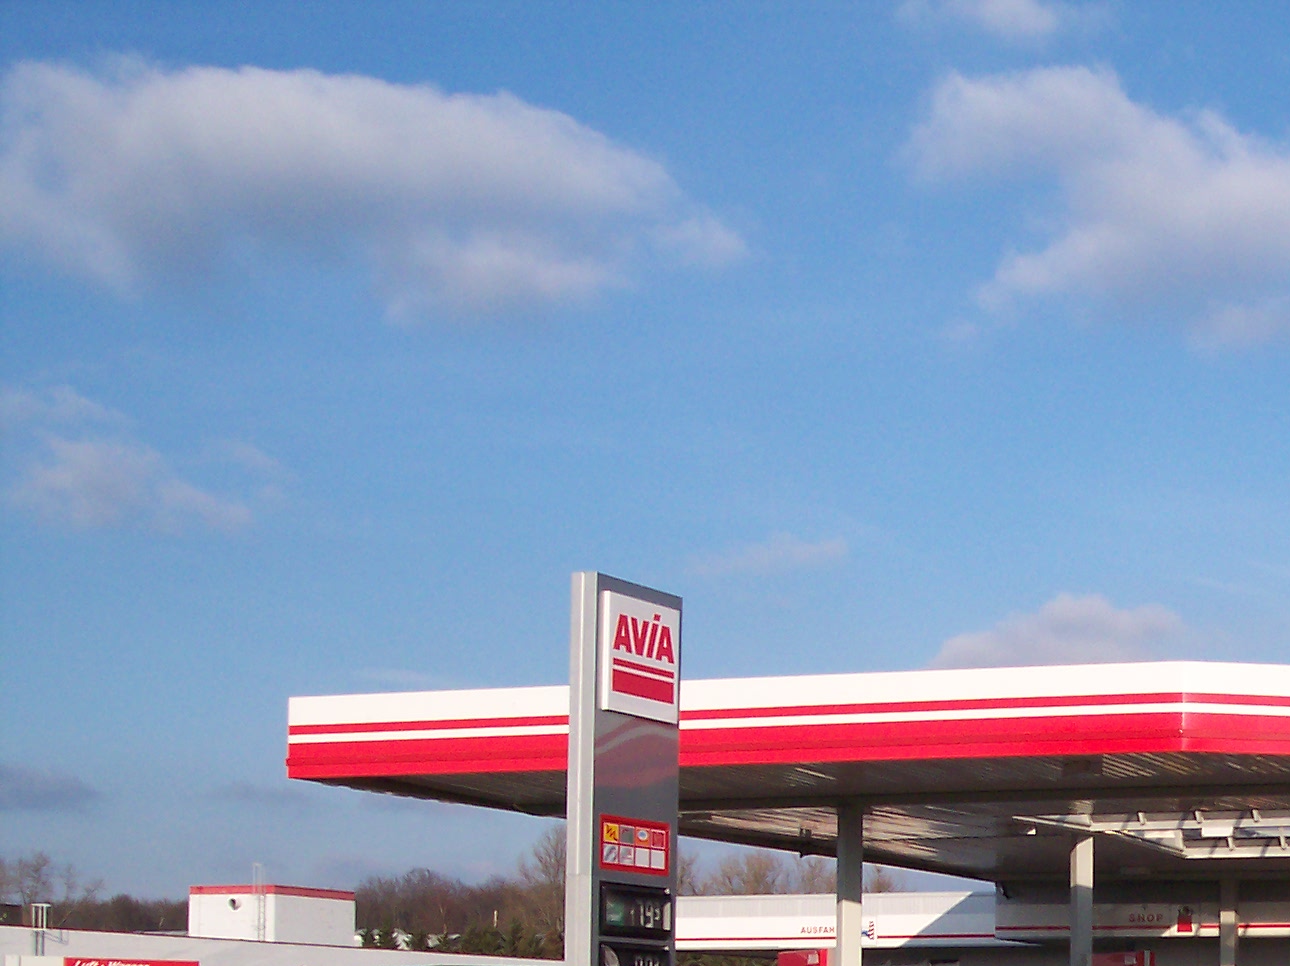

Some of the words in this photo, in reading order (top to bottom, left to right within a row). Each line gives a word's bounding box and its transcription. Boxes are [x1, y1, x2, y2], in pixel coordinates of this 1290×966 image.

[613, 613, 675, 665] AVIA
[1129, 913, 1164, 923] SHOP
[800, 926, 835, 934] AUSFAH
